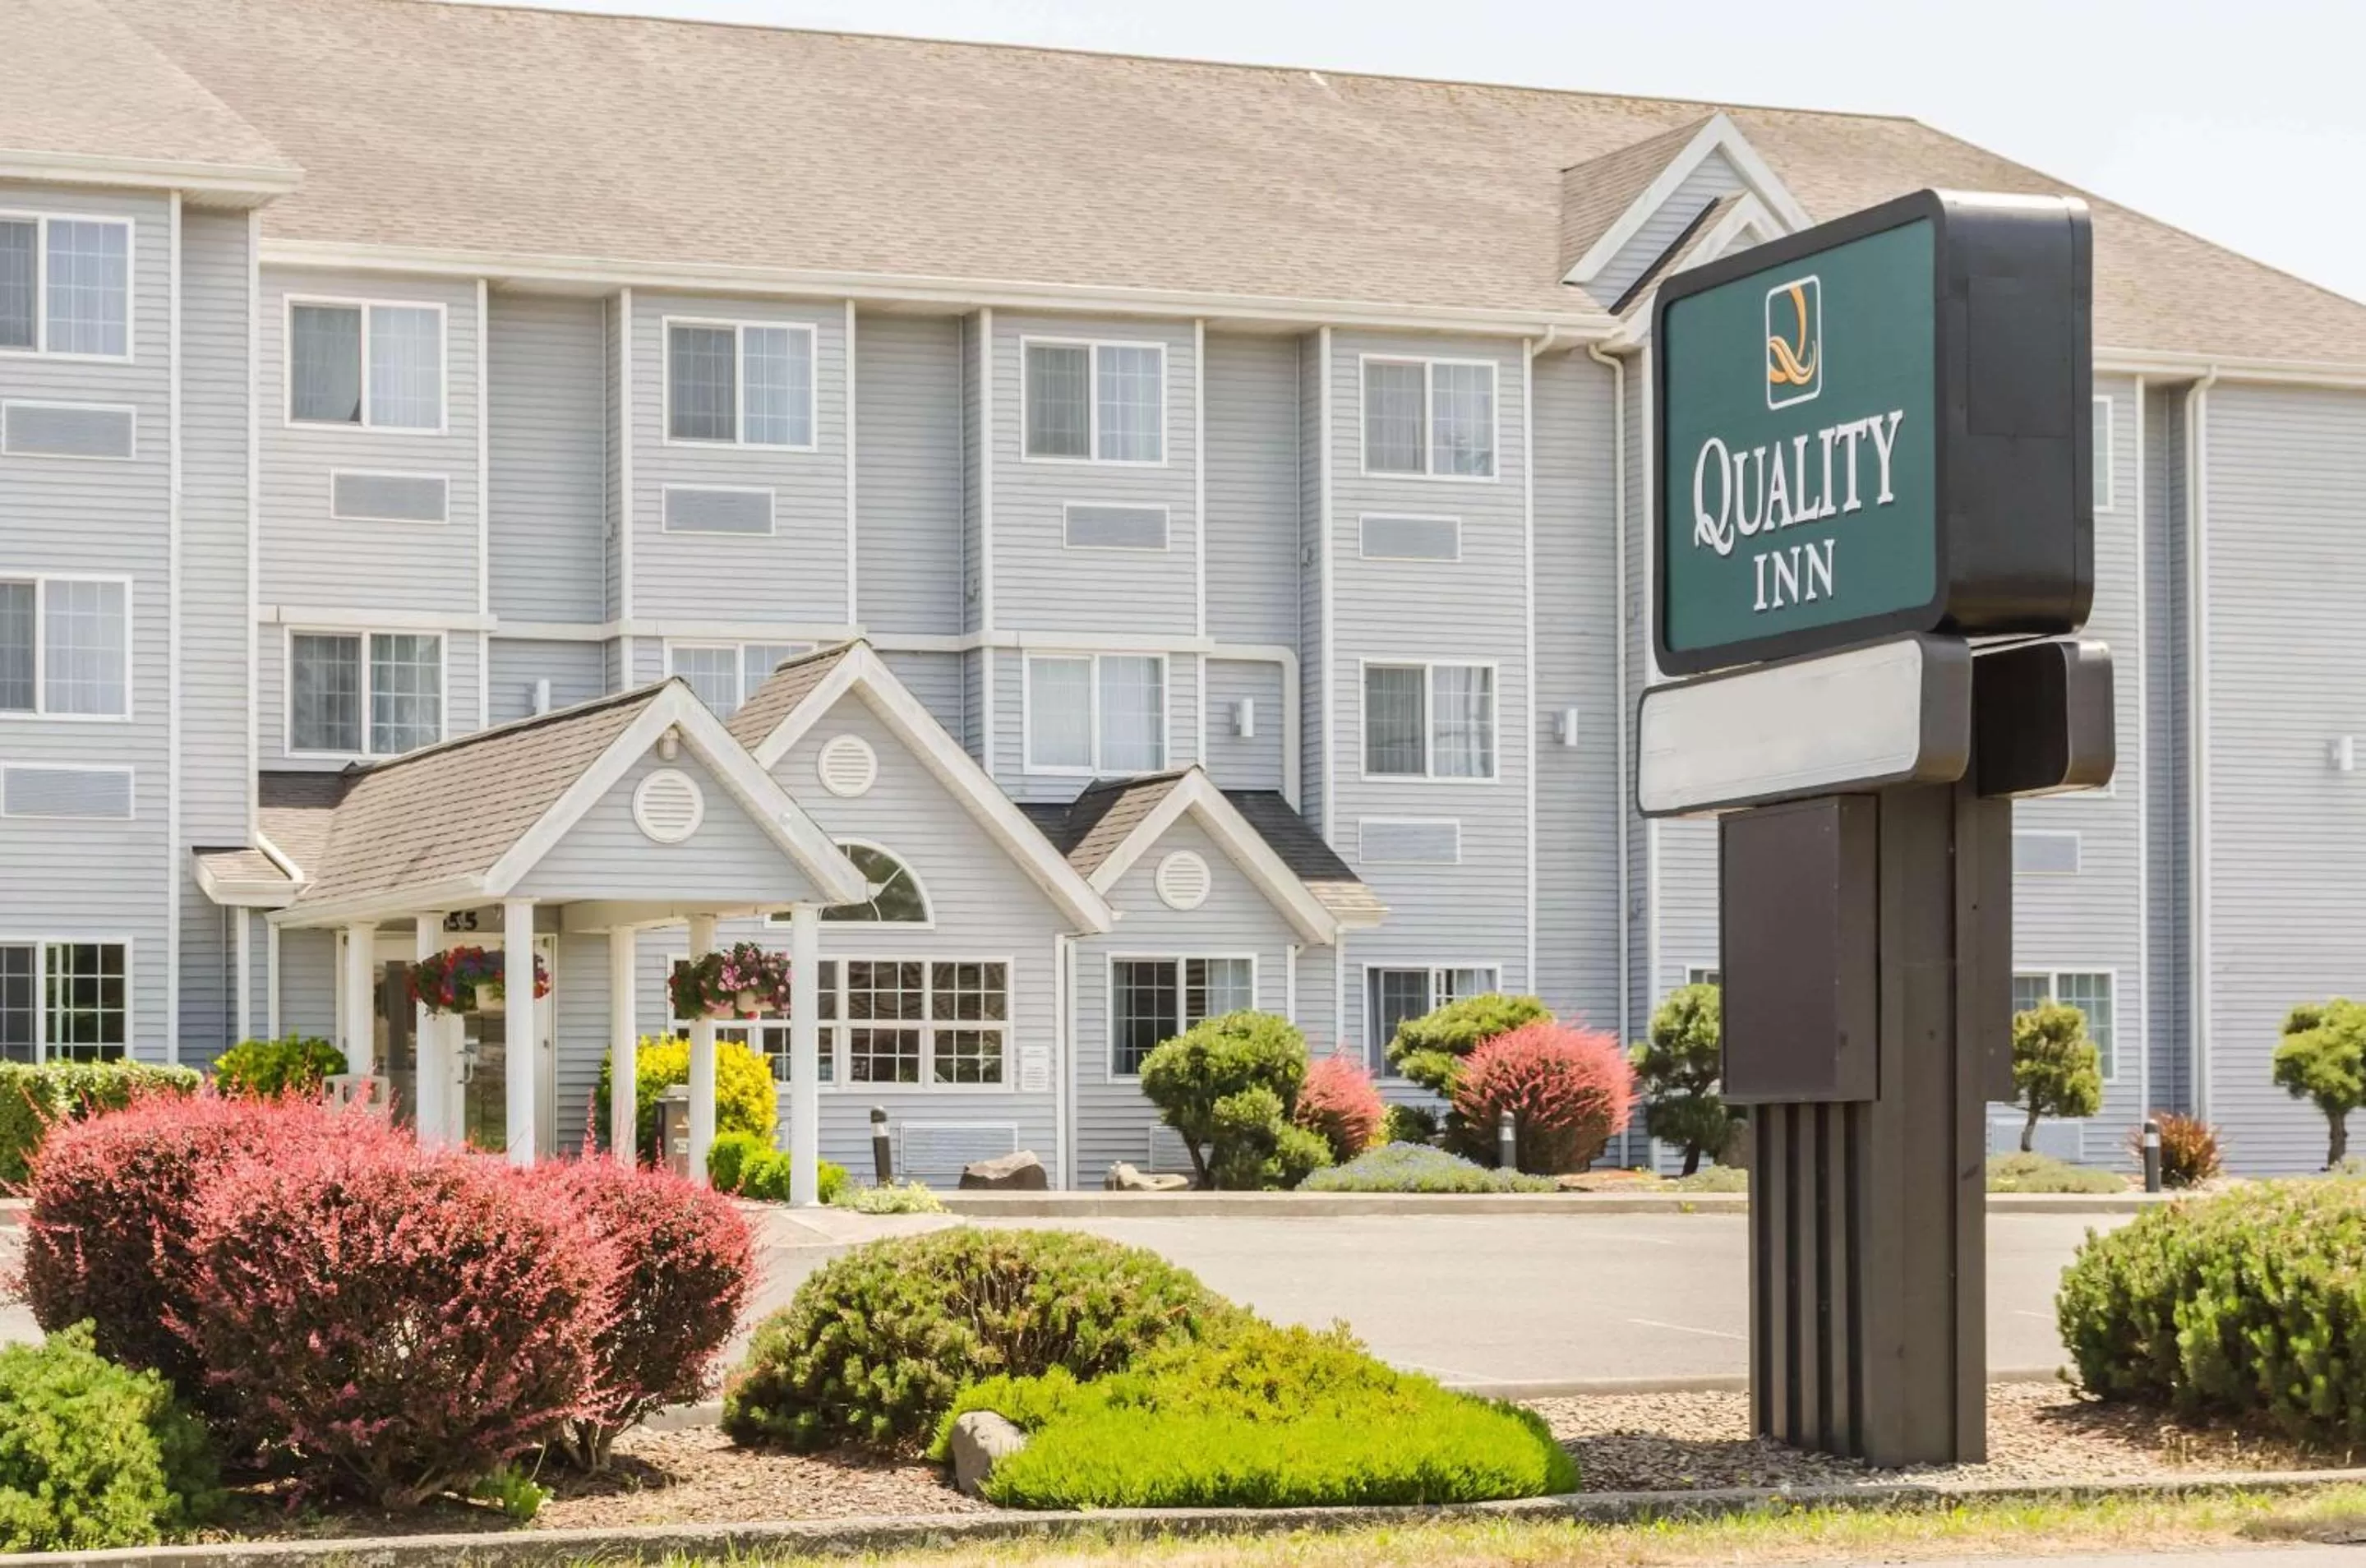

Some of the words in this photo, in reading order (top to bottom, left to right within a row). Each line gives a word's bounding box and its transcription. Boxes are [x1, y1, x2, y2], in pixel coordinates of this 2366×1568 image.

[1693, 410, 1904, 556] QUALITY
[1753, 538, 1835, 611] INN
[443, 911, 478, 931] 55
